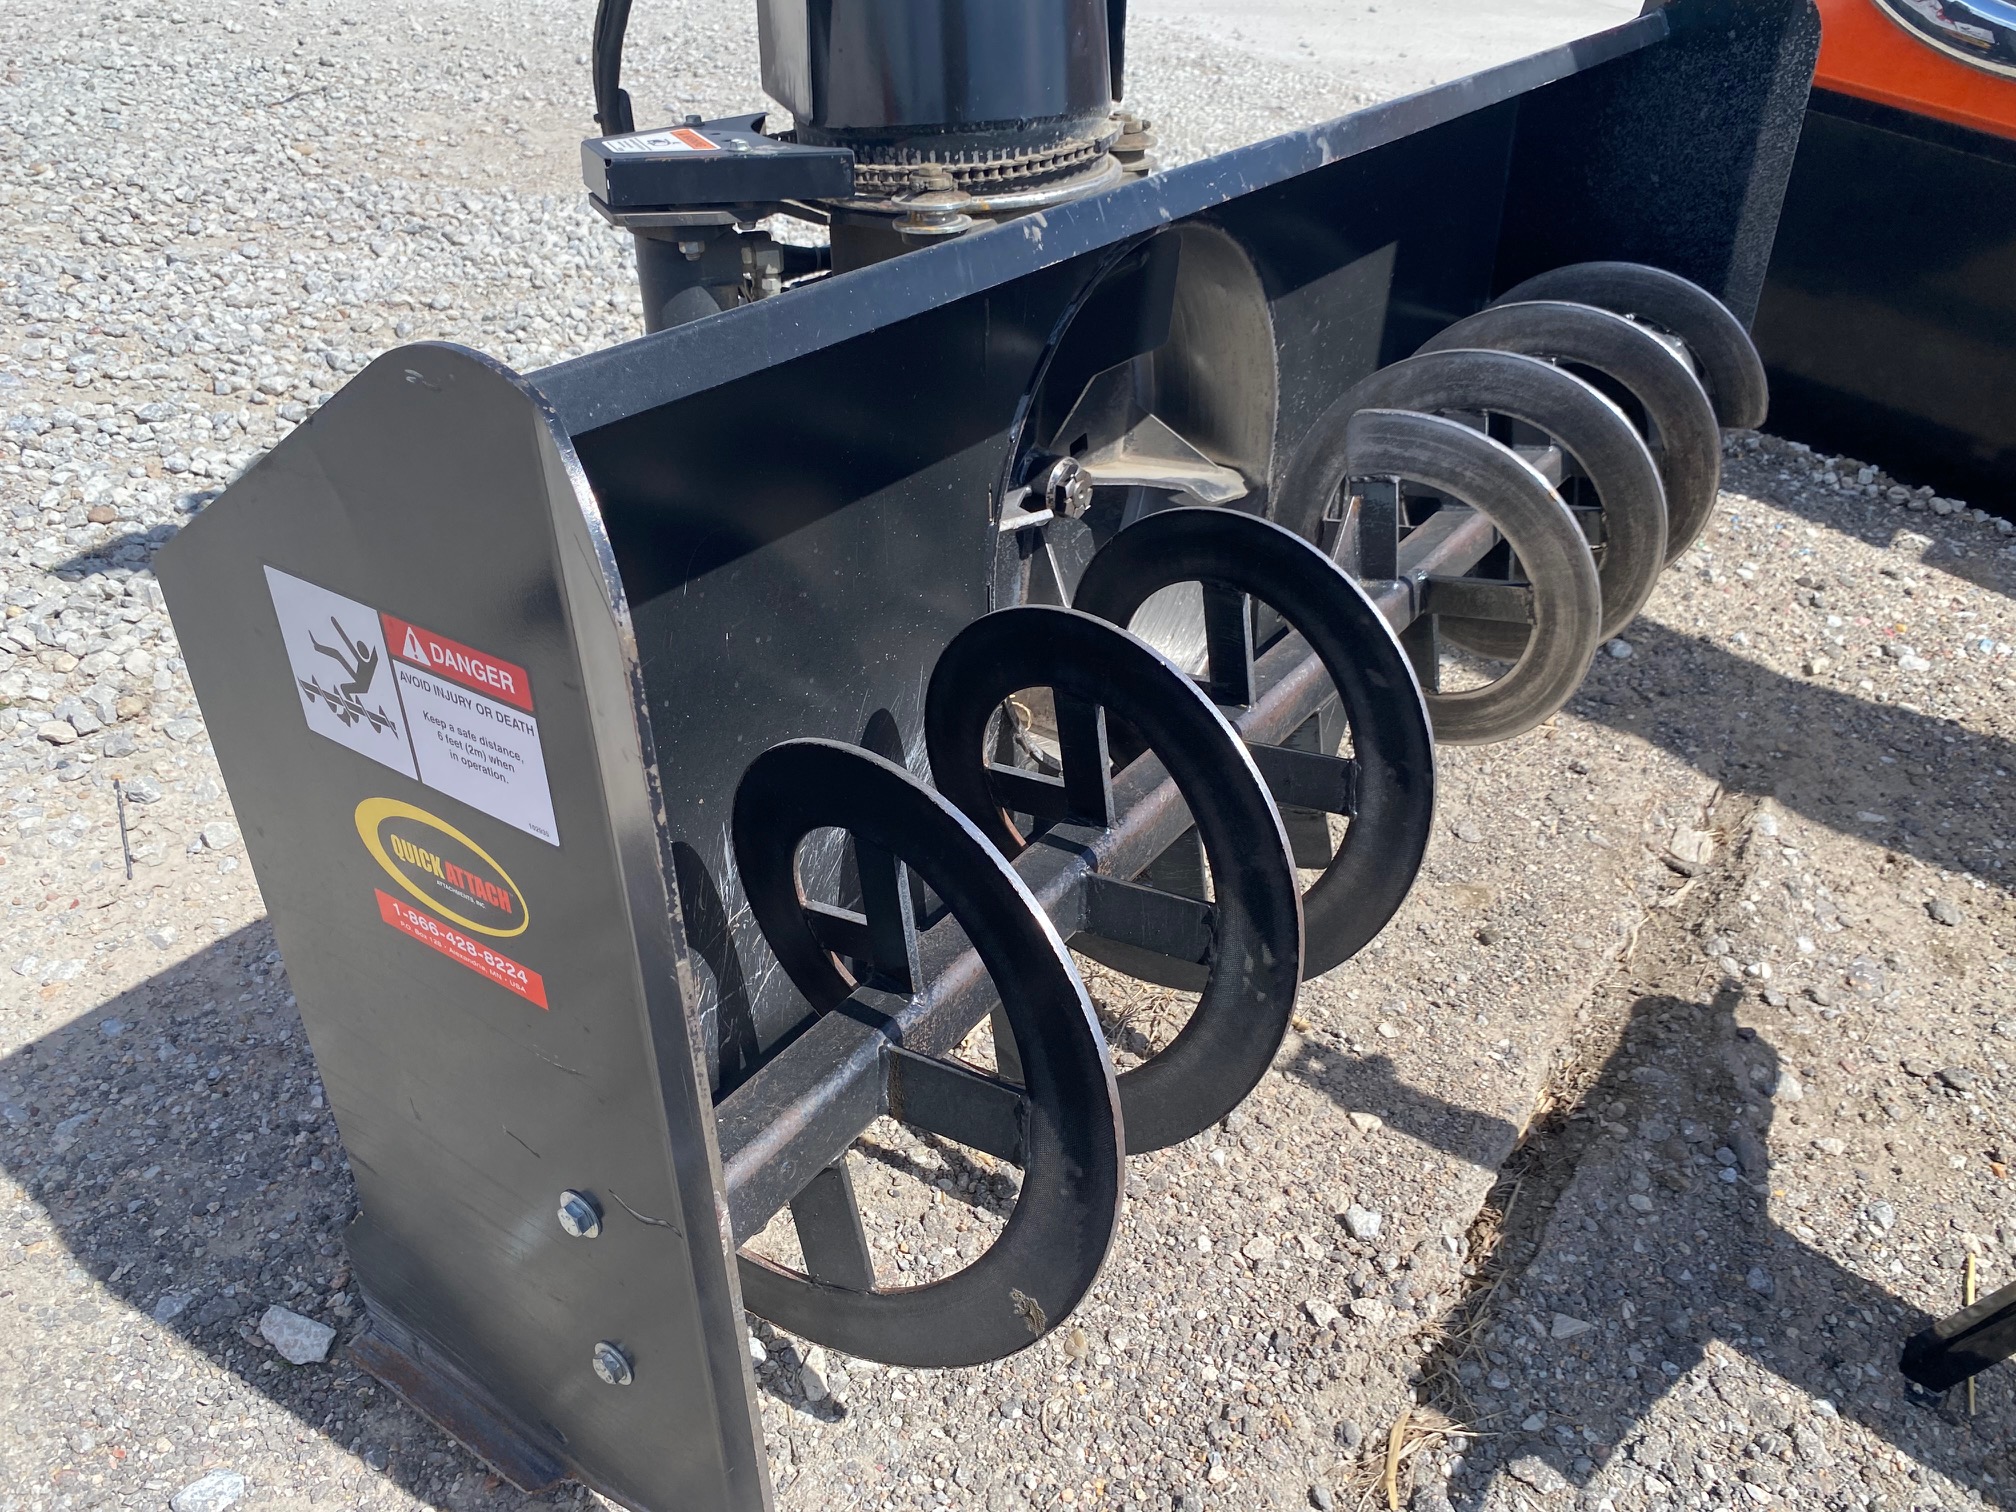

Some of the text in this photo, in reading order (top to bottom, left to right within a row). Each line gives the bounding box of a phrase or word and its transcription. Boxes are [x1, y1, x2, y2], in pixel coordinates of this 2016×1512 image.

[429, 642, 515, 694] DANGER
[400, 671, 535, 737] AVOID INJURY OR DEATH
[423, 710, 525, 765] Keep a safe distance,
[437, 731, 515, 773] 6 feet (2m) when
[449, 749, 509, 785] in operation.
[390, 834, 513, 914] QUICK ATTACH
[393, 903, 528, 984] 1-866-428-8224
[415, 928, 428, 940] Box
[489, 968, 503, 981] MN
[509, 979, 527, 994] USA
